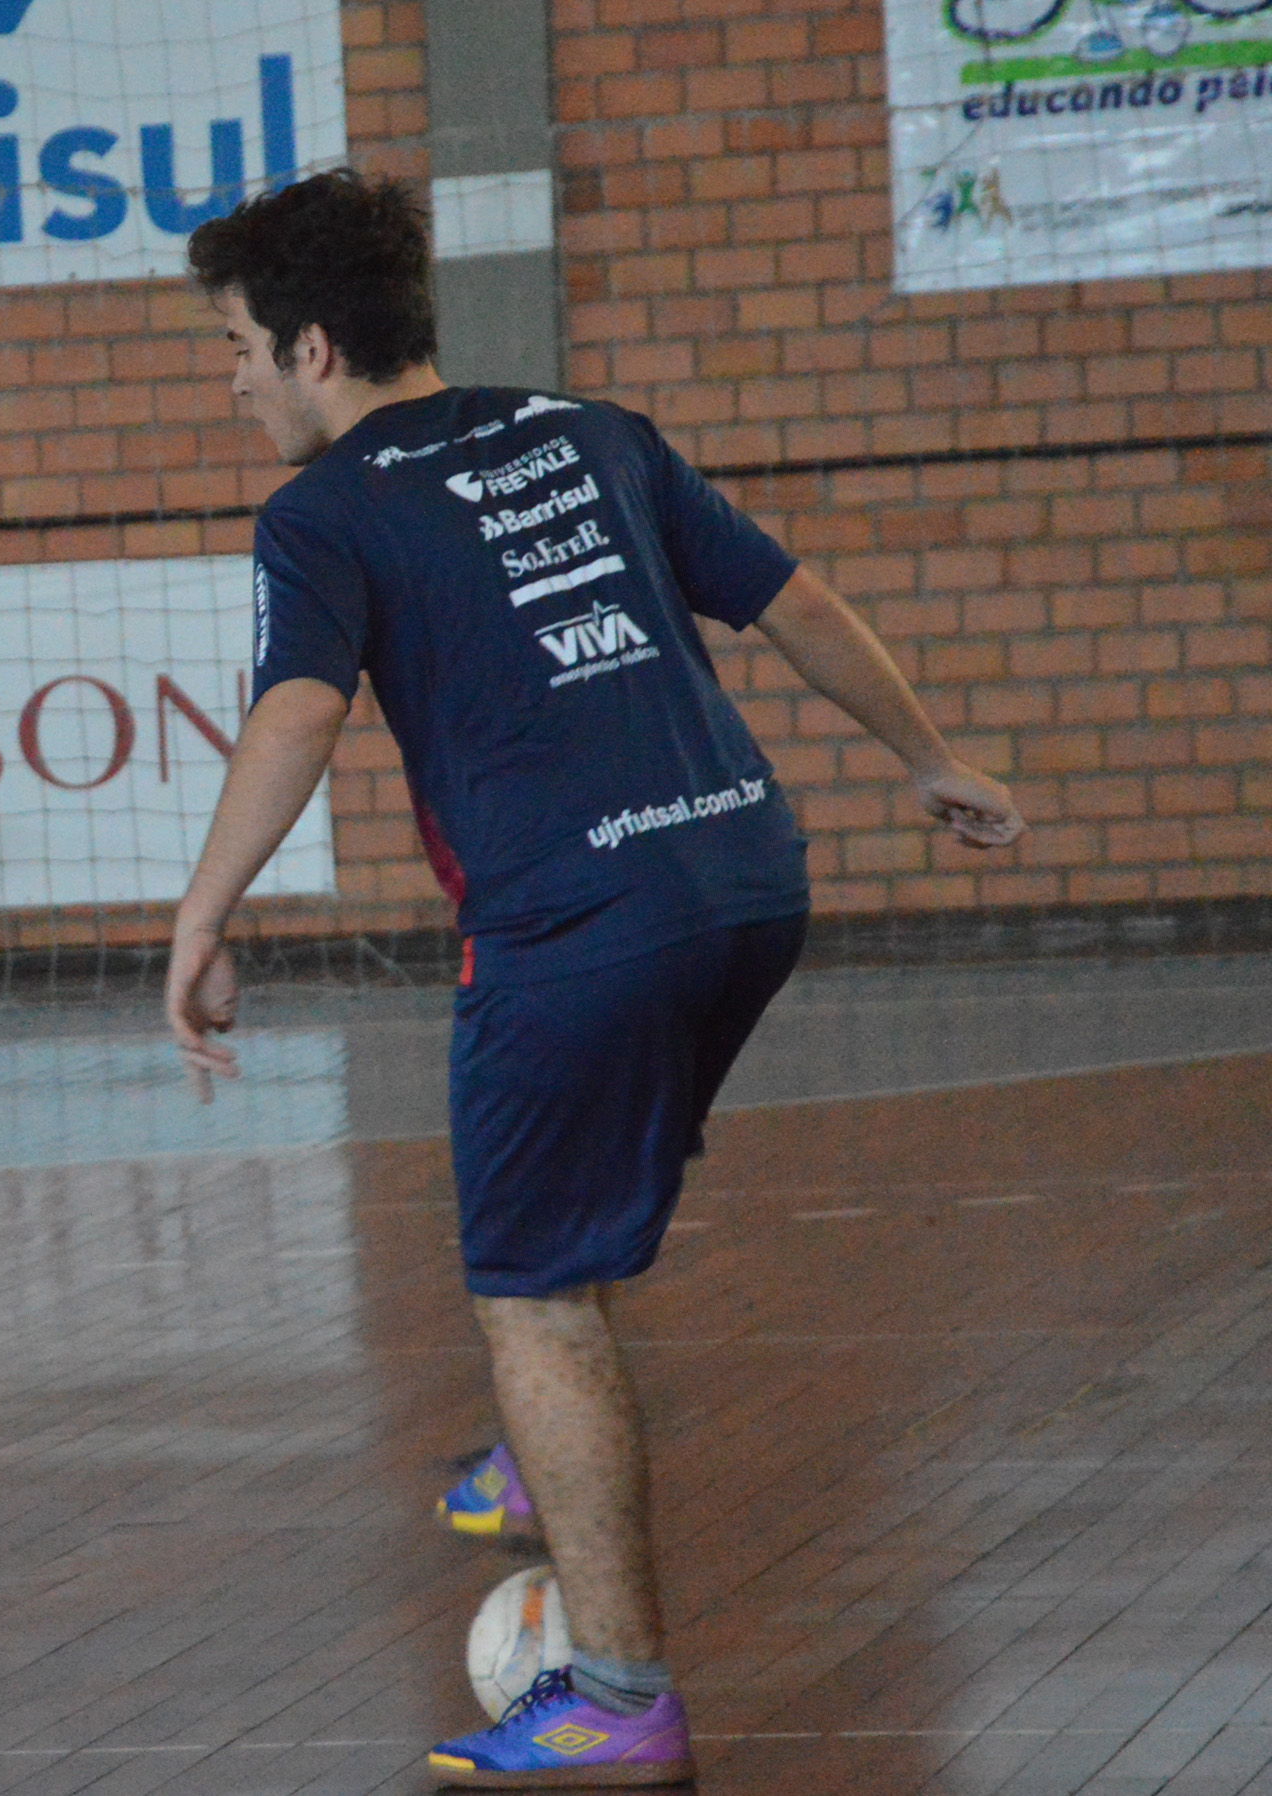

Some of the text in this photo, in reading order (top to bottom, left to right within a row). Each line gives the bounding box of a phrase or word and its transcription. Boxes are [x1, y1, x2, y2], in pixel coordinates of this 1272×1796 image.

[962, 70, 1184, 121] educando
[486, 444, 581, 498] FEEVALE
[539, 611, 649, 667] VIVA
[586, 778, 766, 850] ujrfutsal.com.br
